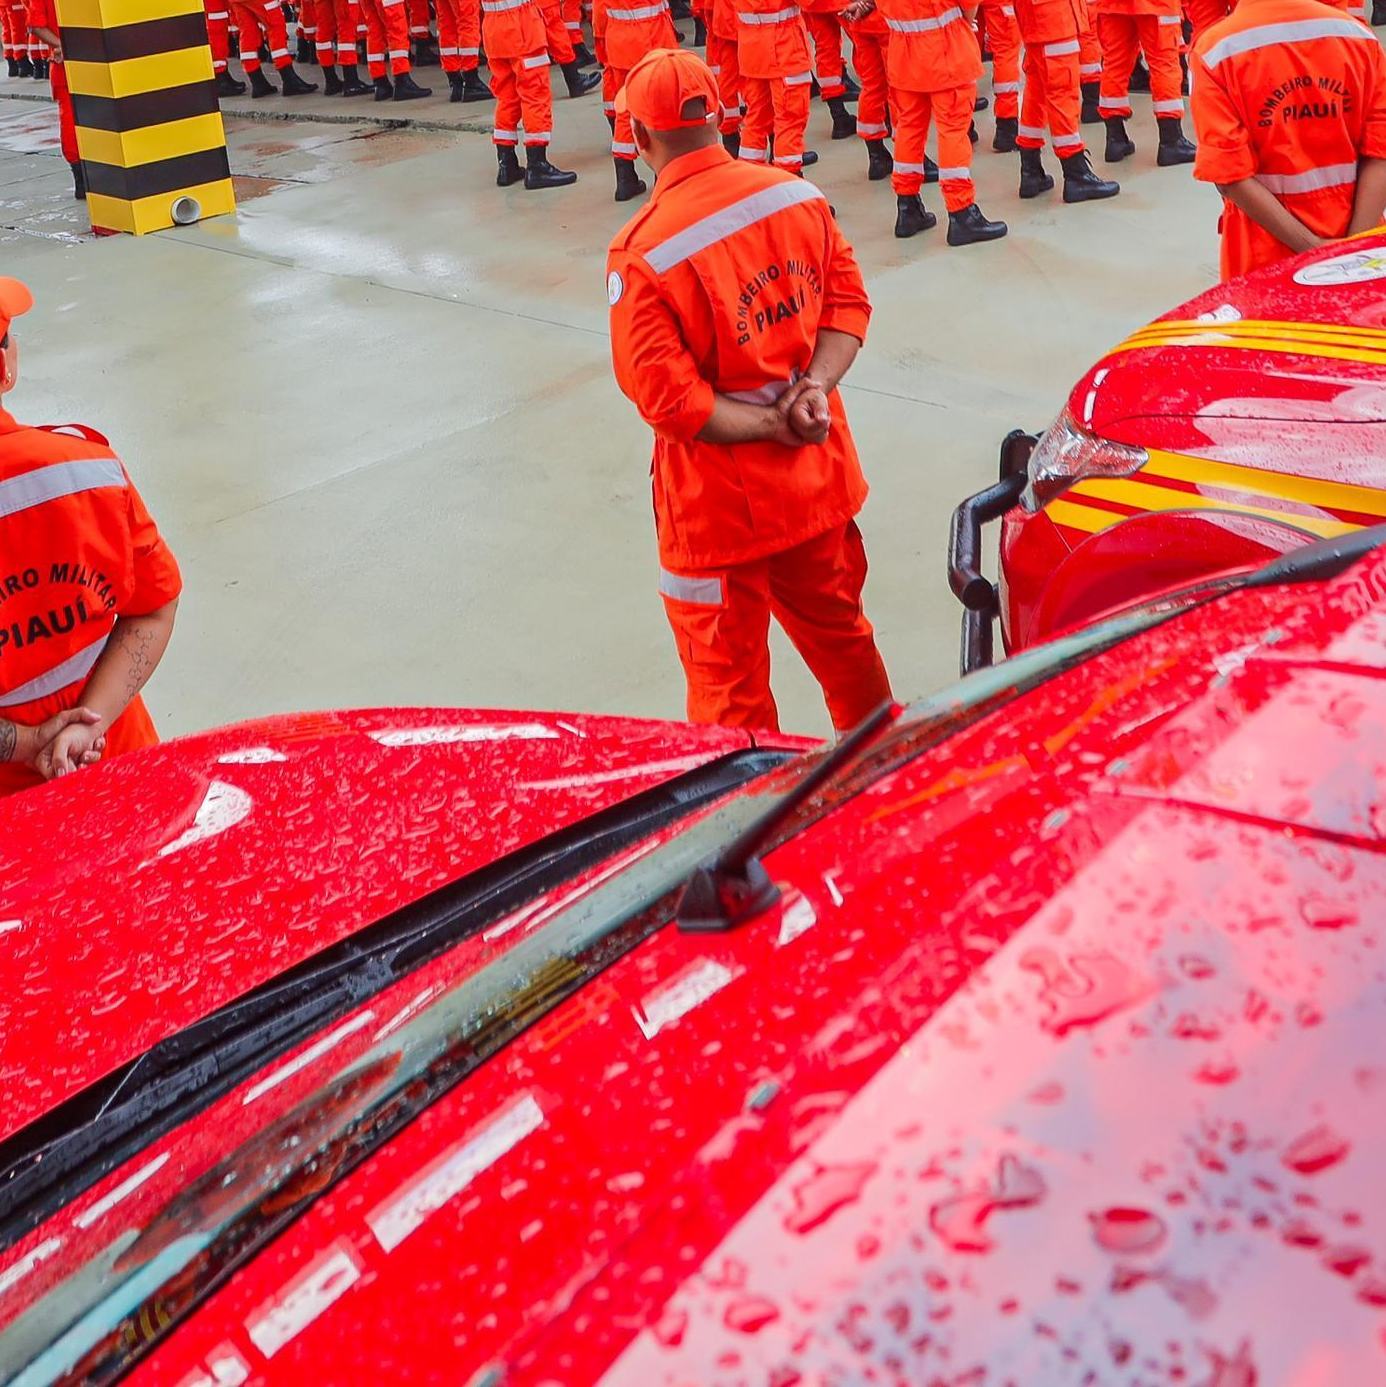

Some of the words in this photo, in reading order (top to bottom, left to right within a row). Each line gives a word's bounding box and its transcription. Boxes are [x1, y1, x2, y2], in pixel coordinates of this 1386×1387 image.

[1258, 75, 1313, 128] BOMBEIRO
[1282, 98, 1338, 124] PIAUÍ
[737, 263, 781, 347] BOMBEIRO
[786, 260, 823, 300] MILITAR
[754, 289, 807, 334] PIAUÍ
[49, 561, 117, 613] MILITAR
